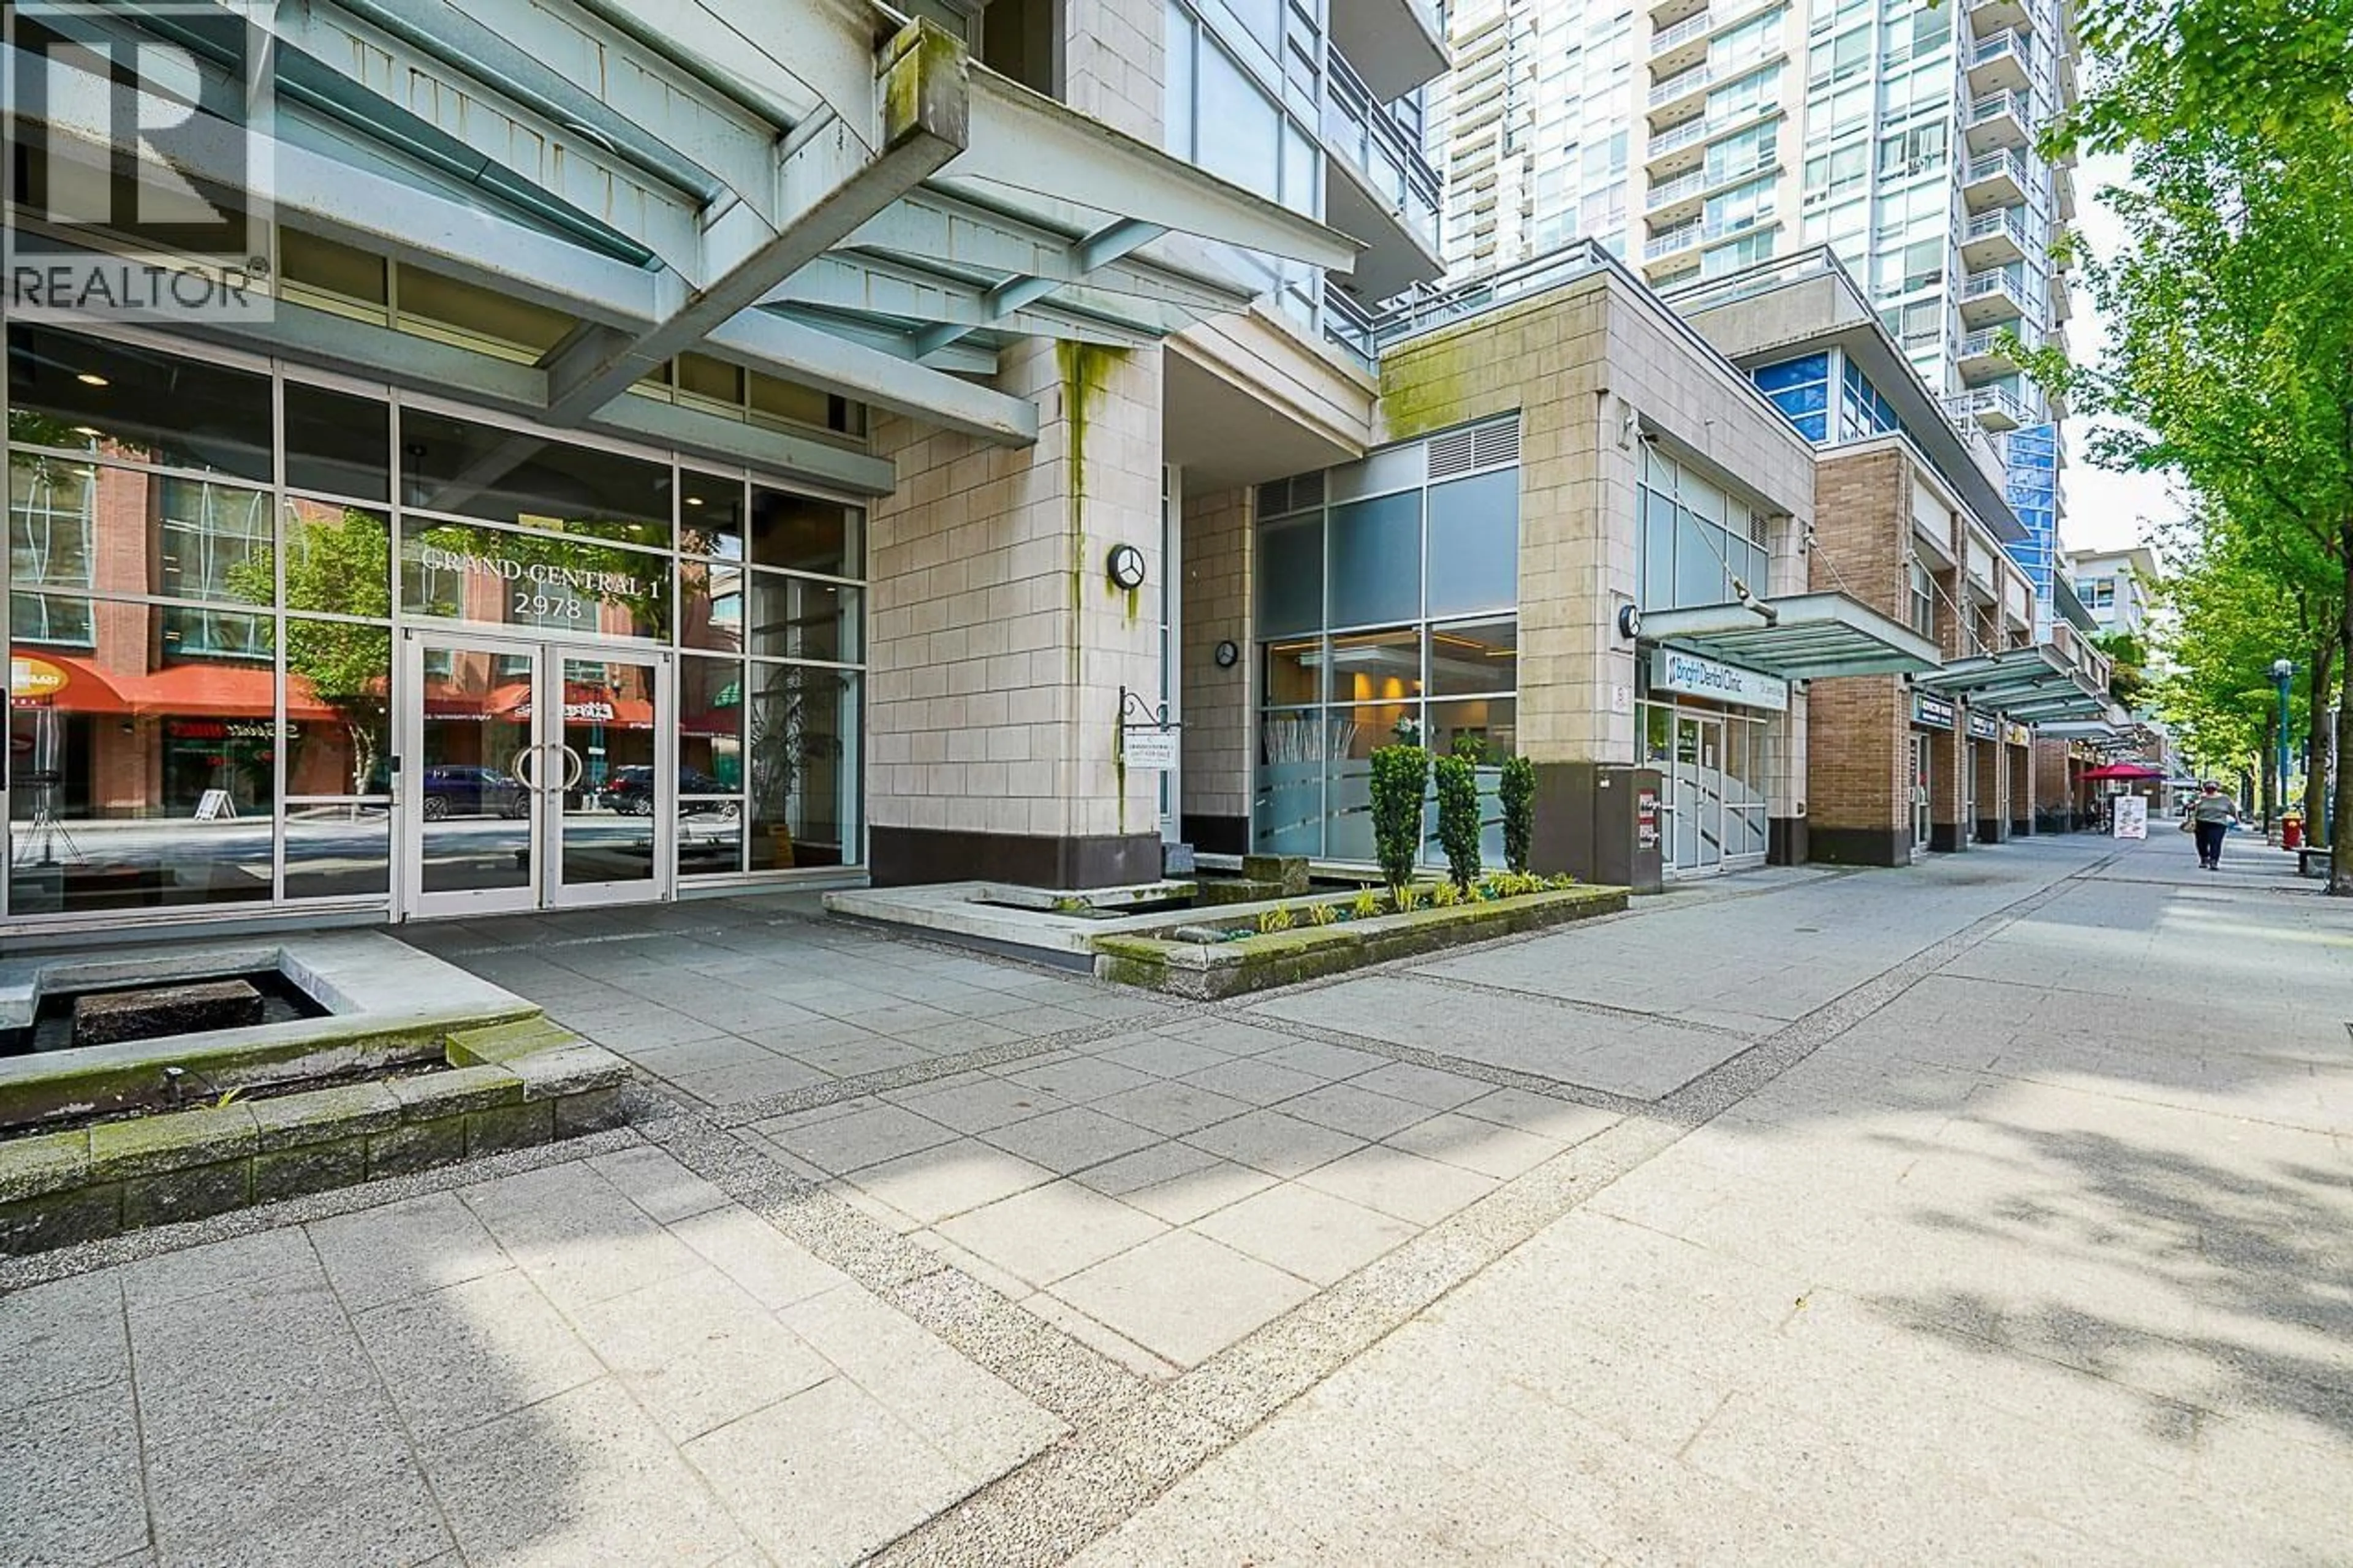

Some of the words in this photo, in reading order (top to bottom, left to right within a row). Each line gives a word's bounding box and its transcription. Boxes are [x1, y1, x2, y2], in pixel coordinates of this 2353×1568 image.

[422, 548, 521, 581] GRAND
[529, 564, 642, 596] CENTRAL
[650, 581, 659, 599] 1
[514, 593, 582, 619] 2978
[1677, 657, 1699, 688] Bright
[1700, 662, 1723, 689] Dental
[1724, 669, 1742, 692] Clinic
